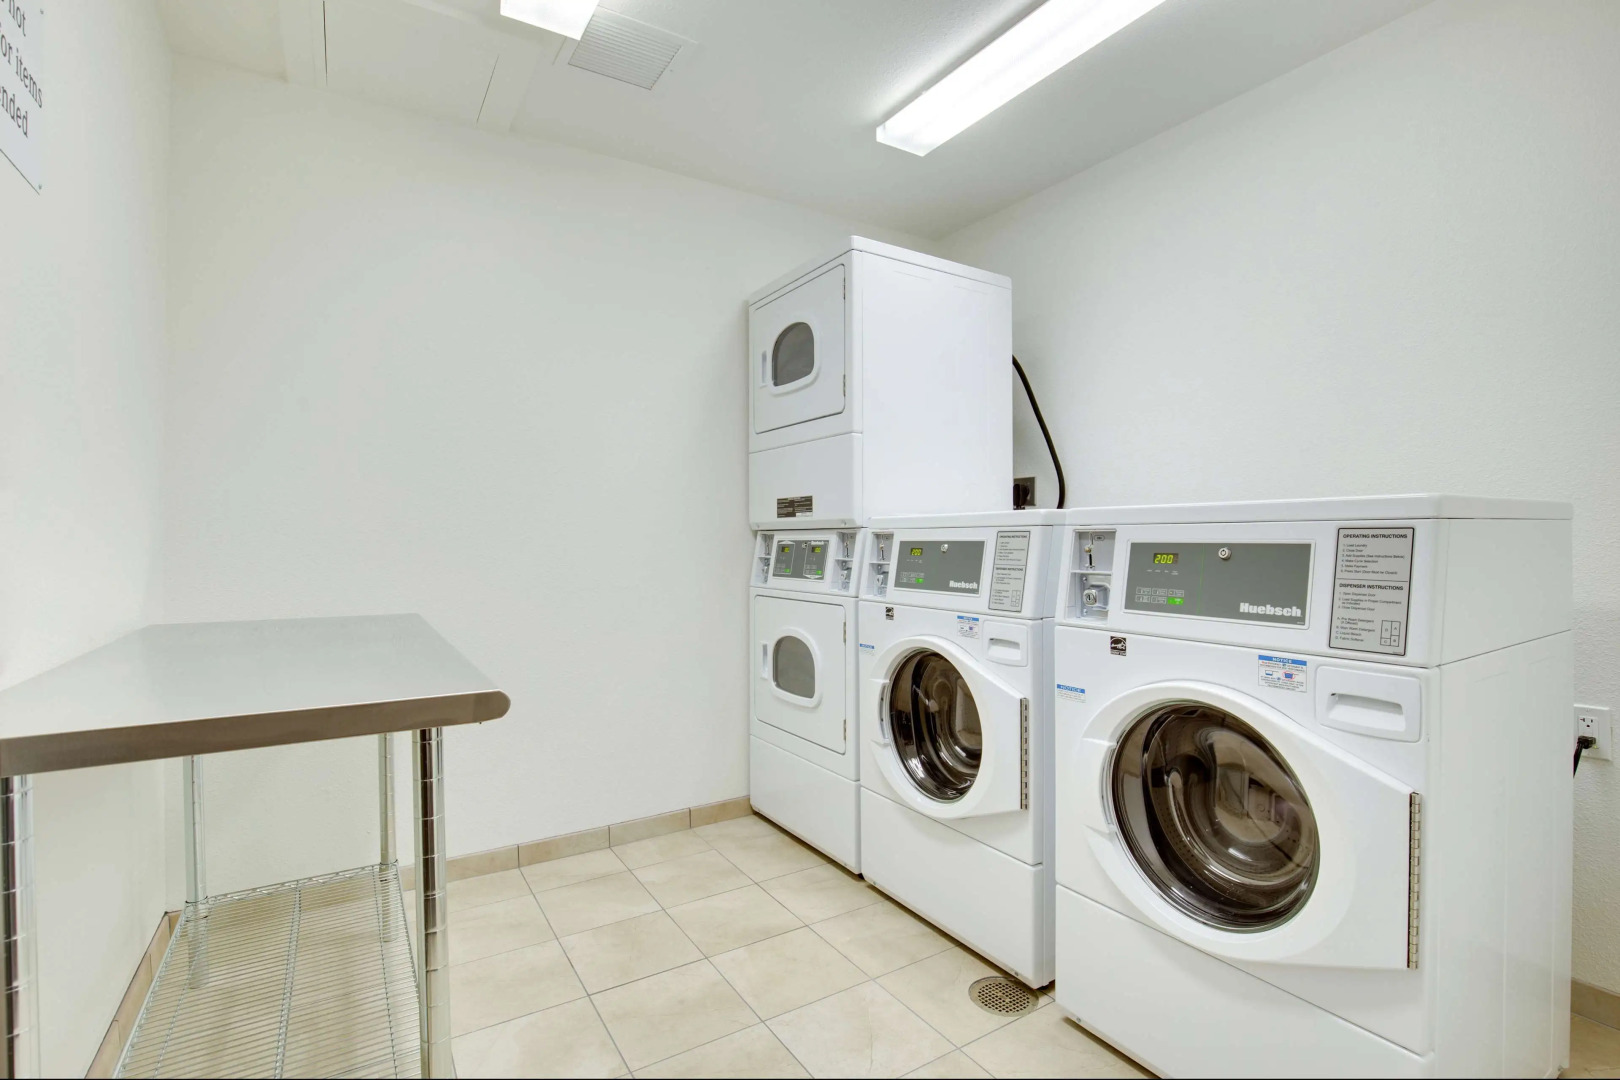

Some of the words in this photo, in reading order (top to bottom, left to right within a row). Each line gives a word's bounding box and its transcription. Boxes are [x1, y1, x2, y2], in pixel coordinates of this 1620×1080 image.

[9, 0, 26, 37] not
[0, 33, 13, 65] or
[15, 48, 43, 109] items
[0, 85, 28, 138] nded
[1154, 554, 1174, 564] 200
[1240, 602, 1302, 617] Huebsch
